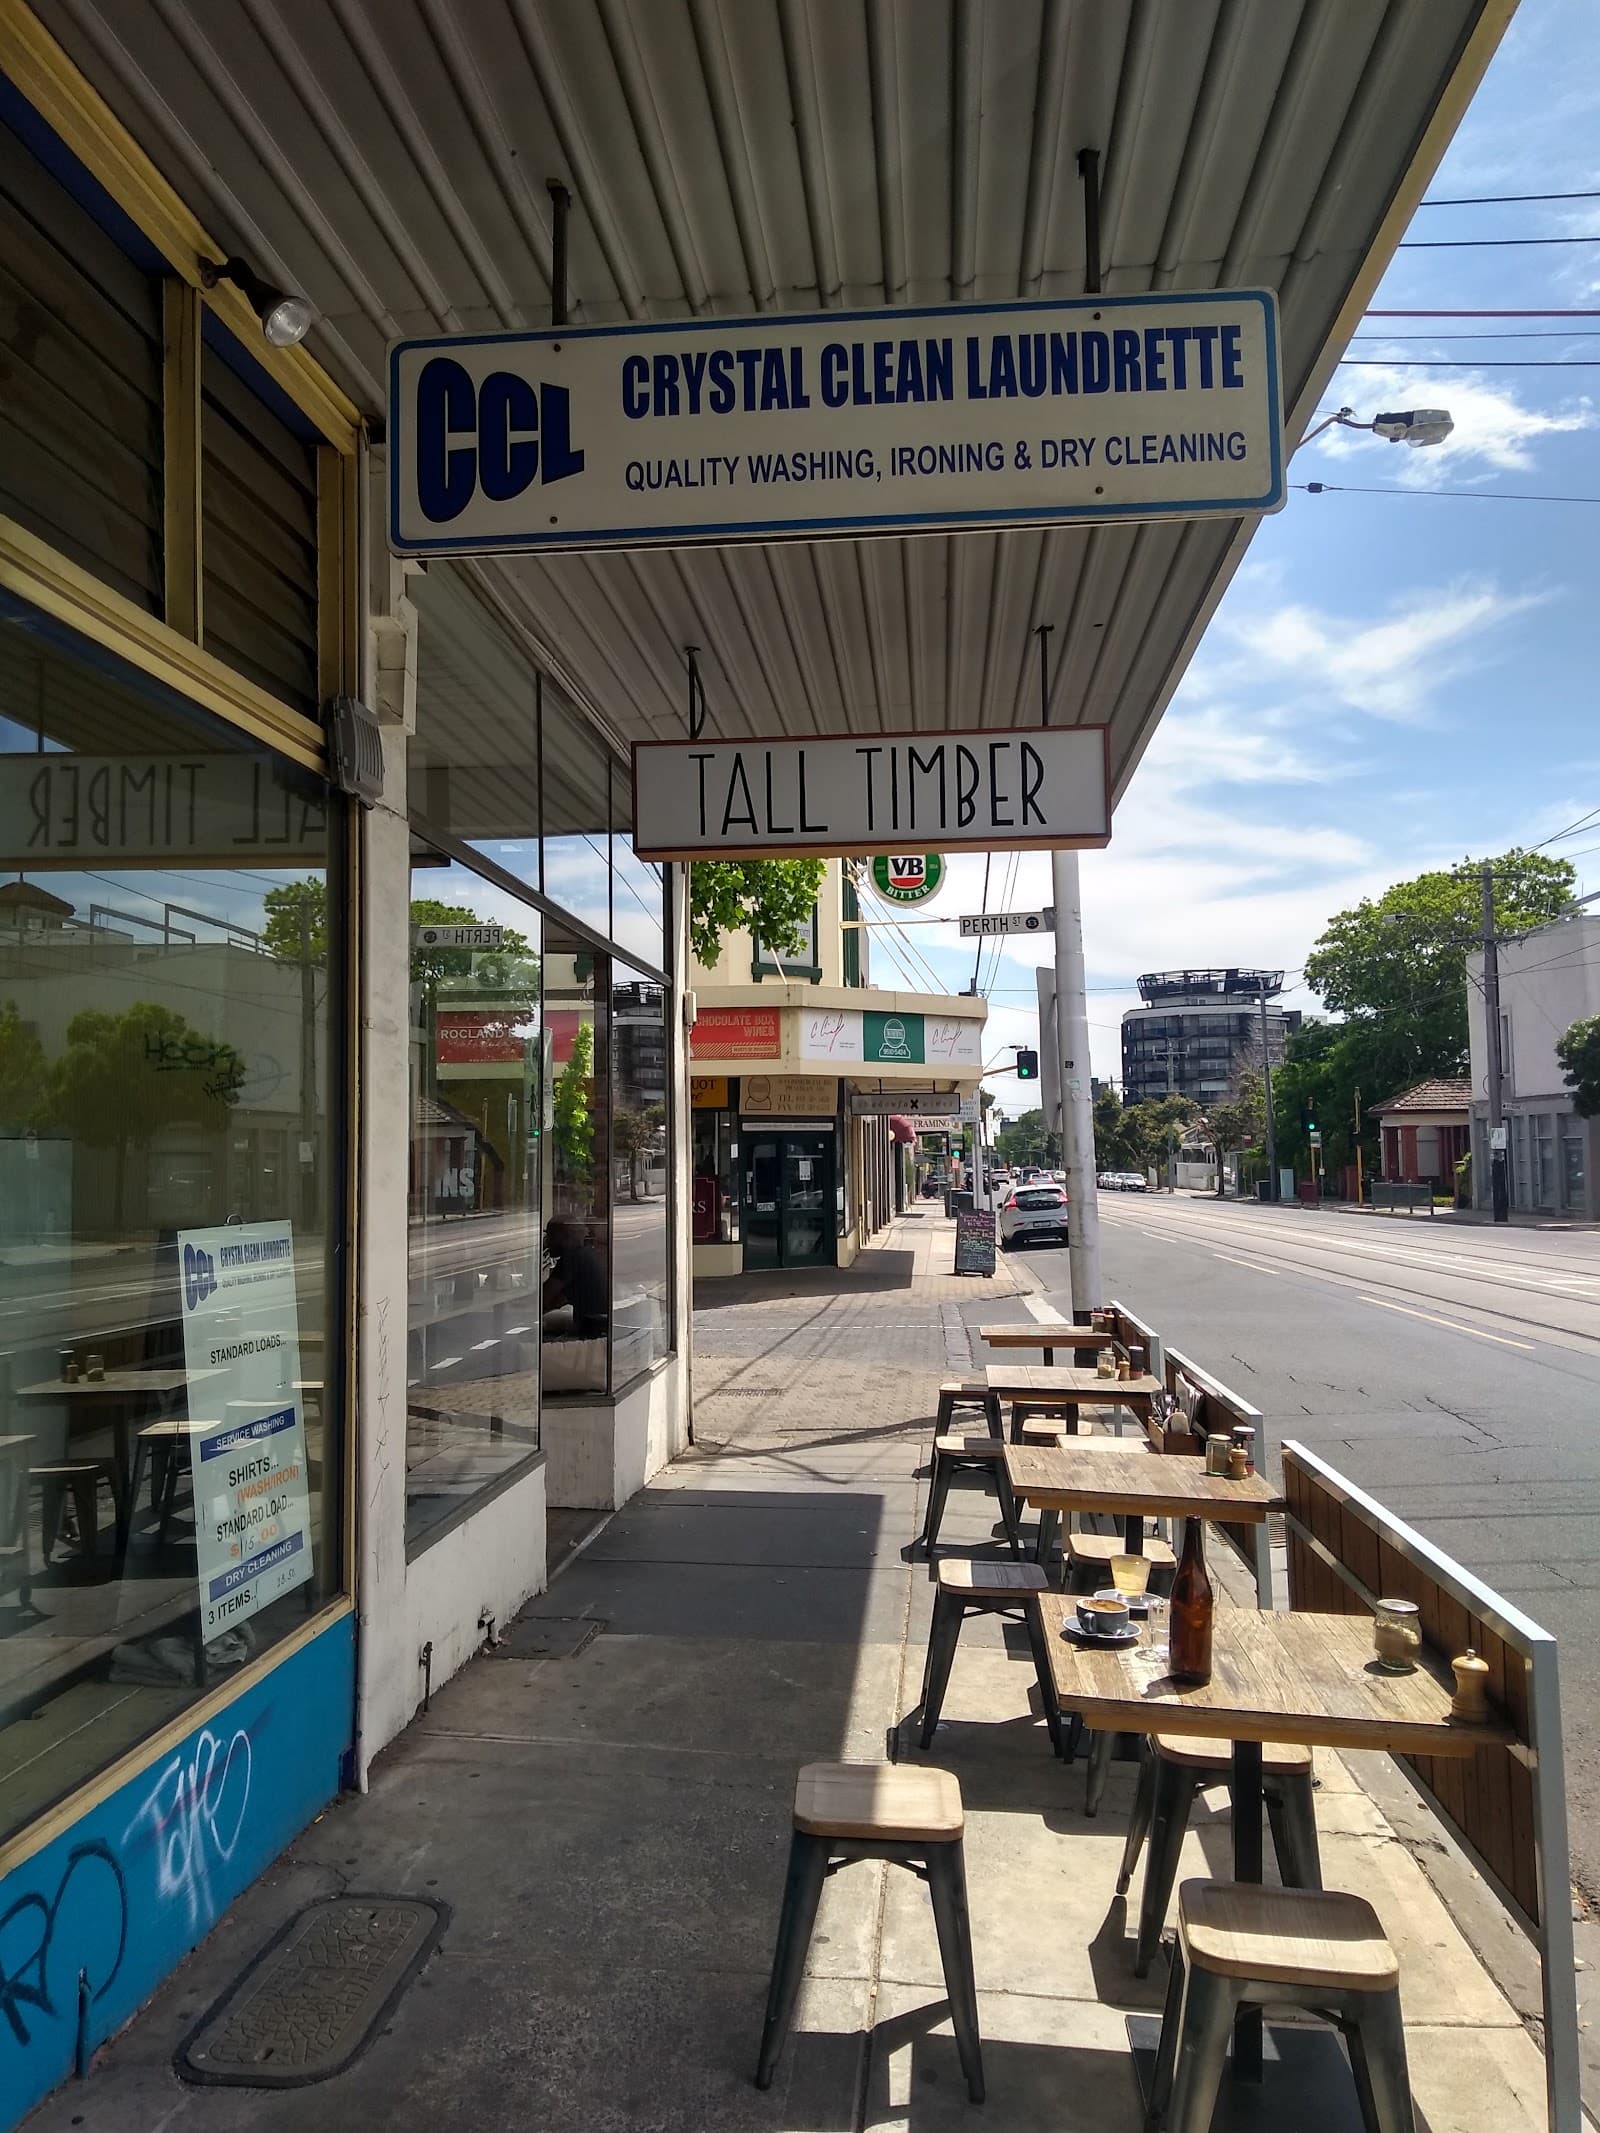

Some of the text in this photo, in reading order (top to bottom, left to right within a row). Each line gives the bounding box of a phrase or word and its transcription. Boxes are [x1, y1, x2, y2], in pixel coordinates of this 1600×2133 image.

[622, 325, 1243, 420] CRYSTAL CLEAN LAUNDRETTE
[417, 357, 584, 523] CCL
[625, 431, 1247, 492] QUALITY WASHING, IRONING & DRY CLEANING
[688, 742, 1047, 836] TALL TIMBER
[890, 857, 923, 876] VB
[886, 885, 930, 899] BITTER
[963, 917, 1020, 933] PERTH ST
[441, 1029, 503, 1039] ROCLAND
[697, 1015, 751, 1026] CHOCOLATE
[913, 1119, 949, 1128] FRAMING
[220, 1245, 244, 1267] CRYSTAL
[244, 1243, 260, 1264] CLEAN
[183, 1243, 217, 1311] CCL
[210, 1341, 254, 1365] STANDARD
[216, 1416, 285, 1451] SERVICE WASHING
[236, 1466, 299, 1505] (WASH/IRON)
[217, 1511, 264, 1542] STANDARD
[225, 1541, 293, 1588] DRY CLEANING
[208, 1611, 216, 1625] 3
